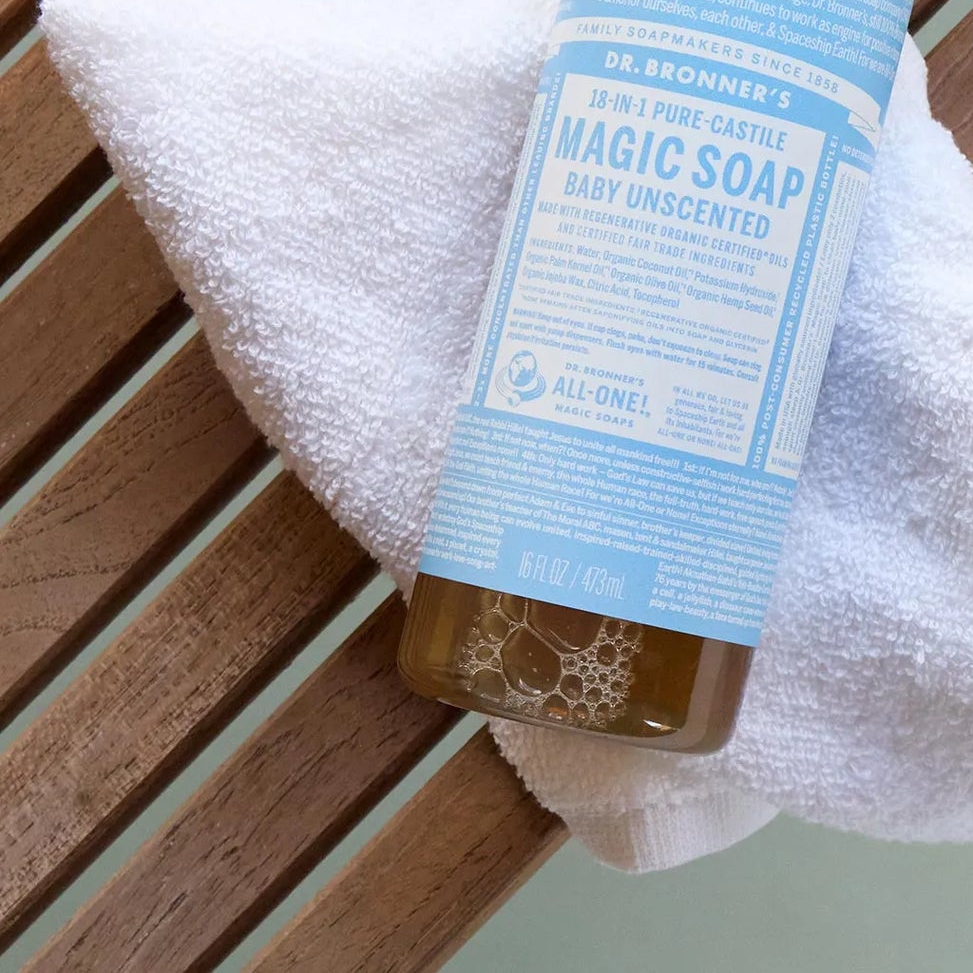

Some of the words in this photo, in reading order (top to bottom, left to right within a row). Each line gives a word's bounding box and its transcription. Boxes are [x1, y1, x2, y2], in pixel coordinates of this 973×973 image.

[700, 7, 729, 25] each
[765, 21, 777, 37] &
[777, 24, 832, 56] Spaceship
[777, 4, 791, 20] to
[791, 9, 819, 28] work
[818, 19, 831, 32] as
[830, 21, 862, 44] engine
[576, 23, 621, 35] FAMILY
[626, 26, 743, 60] SOAPMAKERS
[751, 53, 802, 78] SINCE
[806, 71, 838, 93] 1858
[604, 50, 640, 73] DR.
[644, 58, 791, 108] BRONNER'S
[588, 88, 647, 117] 18-IN-1
[652, 101, 787, 151] PURE-CASTILE
[555, 115, 685, 181] MAGIC
[691, 143, 805, 210] SOAP
[563, 171, 621, 203] BABY
[625, 183, 770, 239] UNSCENTED
[537, 200, 558, 214] MADE
[559, 204, 581, 218] WITH
[582, 209, 657, 234] REGENERATIVE
[660, 225, 708, 246] ORGANIC
[768, 252, 788, 268] OILS
[556, 221, 575, 235] AND
[576, 225, 625, 245] CERTIFIED
[627, 235, 650, 250] FAIR
[653, 241, 685, 258] TRADE
[688, 250, 755, 276] INGREDIENTS
[602, 250, 636, 268] Organic
[636, 257, 673, 275] Coconut
[694, 271, 739, 291] Potassium
[609, 267, 644, 285] Organic
[644, 275, 667, 289] Olive
[685, 284, 720, 303] Organic
[719, 293, 744, 310] Hemp
[751, 434, 766, 469] 100%
[761, 320, 793, 429] POST-CONSUMER
[789, 251, 810, 315] RECYCLED
[805, 193, 824, 246] PLASTIC
[819, 135, 838, 188] BOTTLE!
[565, 362, 581, 372] DR.
[583, 366, 644, 386] BRONNER'S
[554, 403, 591, 418] MAGIC
[595, 412, 634, 427] SOAPS
[517, 550, 534, 578] 16
[532, 553, 549, 582] FL
[548, 557, 569, 586] OZ
[568, 562, 582, 589] /
[580, 565, 627, 600] 473mL
